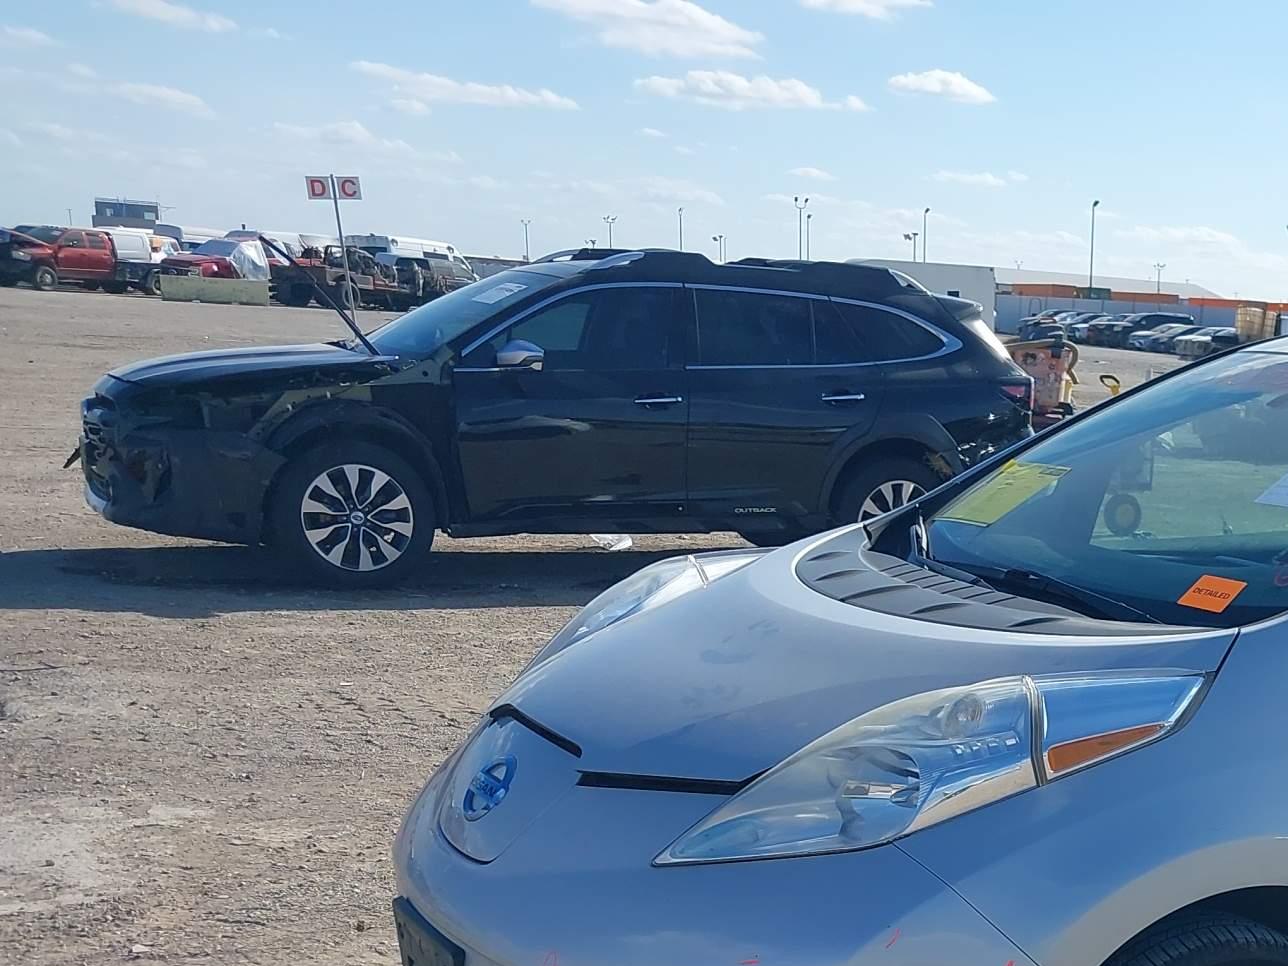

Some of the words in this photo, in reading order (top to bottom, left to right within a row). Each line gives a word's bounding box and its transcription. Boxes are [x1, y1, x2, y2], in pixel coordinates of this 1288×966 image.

[310, 179, 326, 197] D
[341, 179, 357, 197] C
[1192, 586, 1231, 600] DETAILED
